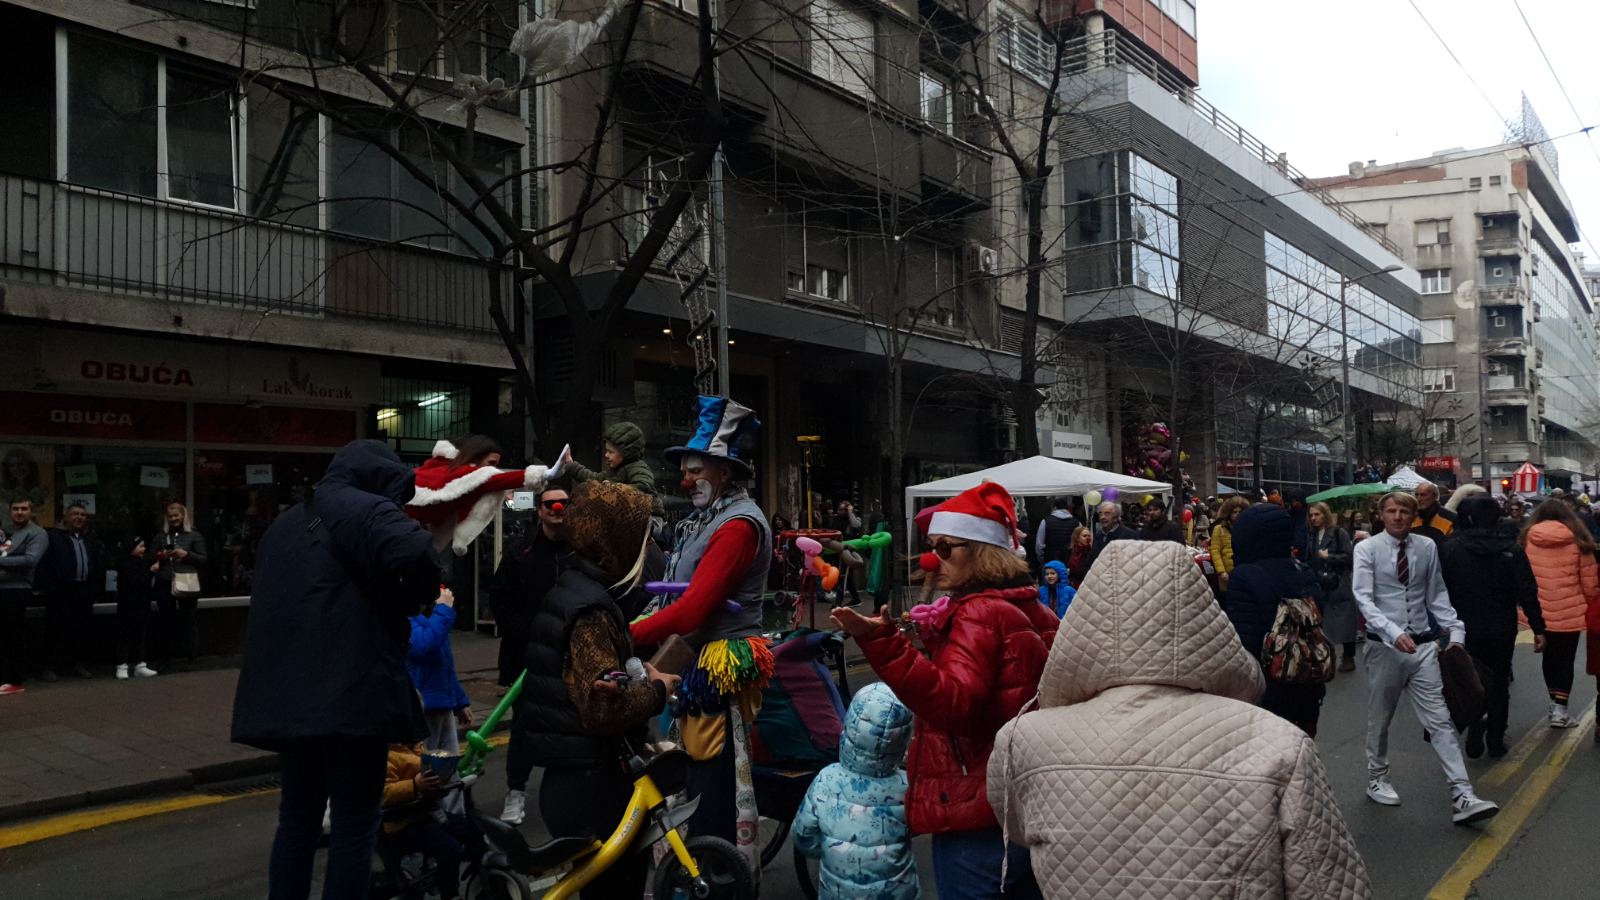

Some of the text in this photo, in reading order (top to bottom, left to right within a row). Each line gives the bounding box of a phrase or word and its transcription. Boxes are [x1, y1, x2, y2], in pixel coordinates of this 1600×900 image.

[81, 361, 193, 386] OBUĆA
[262, 379, 353, 400] Lak korak
[50, 409, 133, 426] OBUĆA
